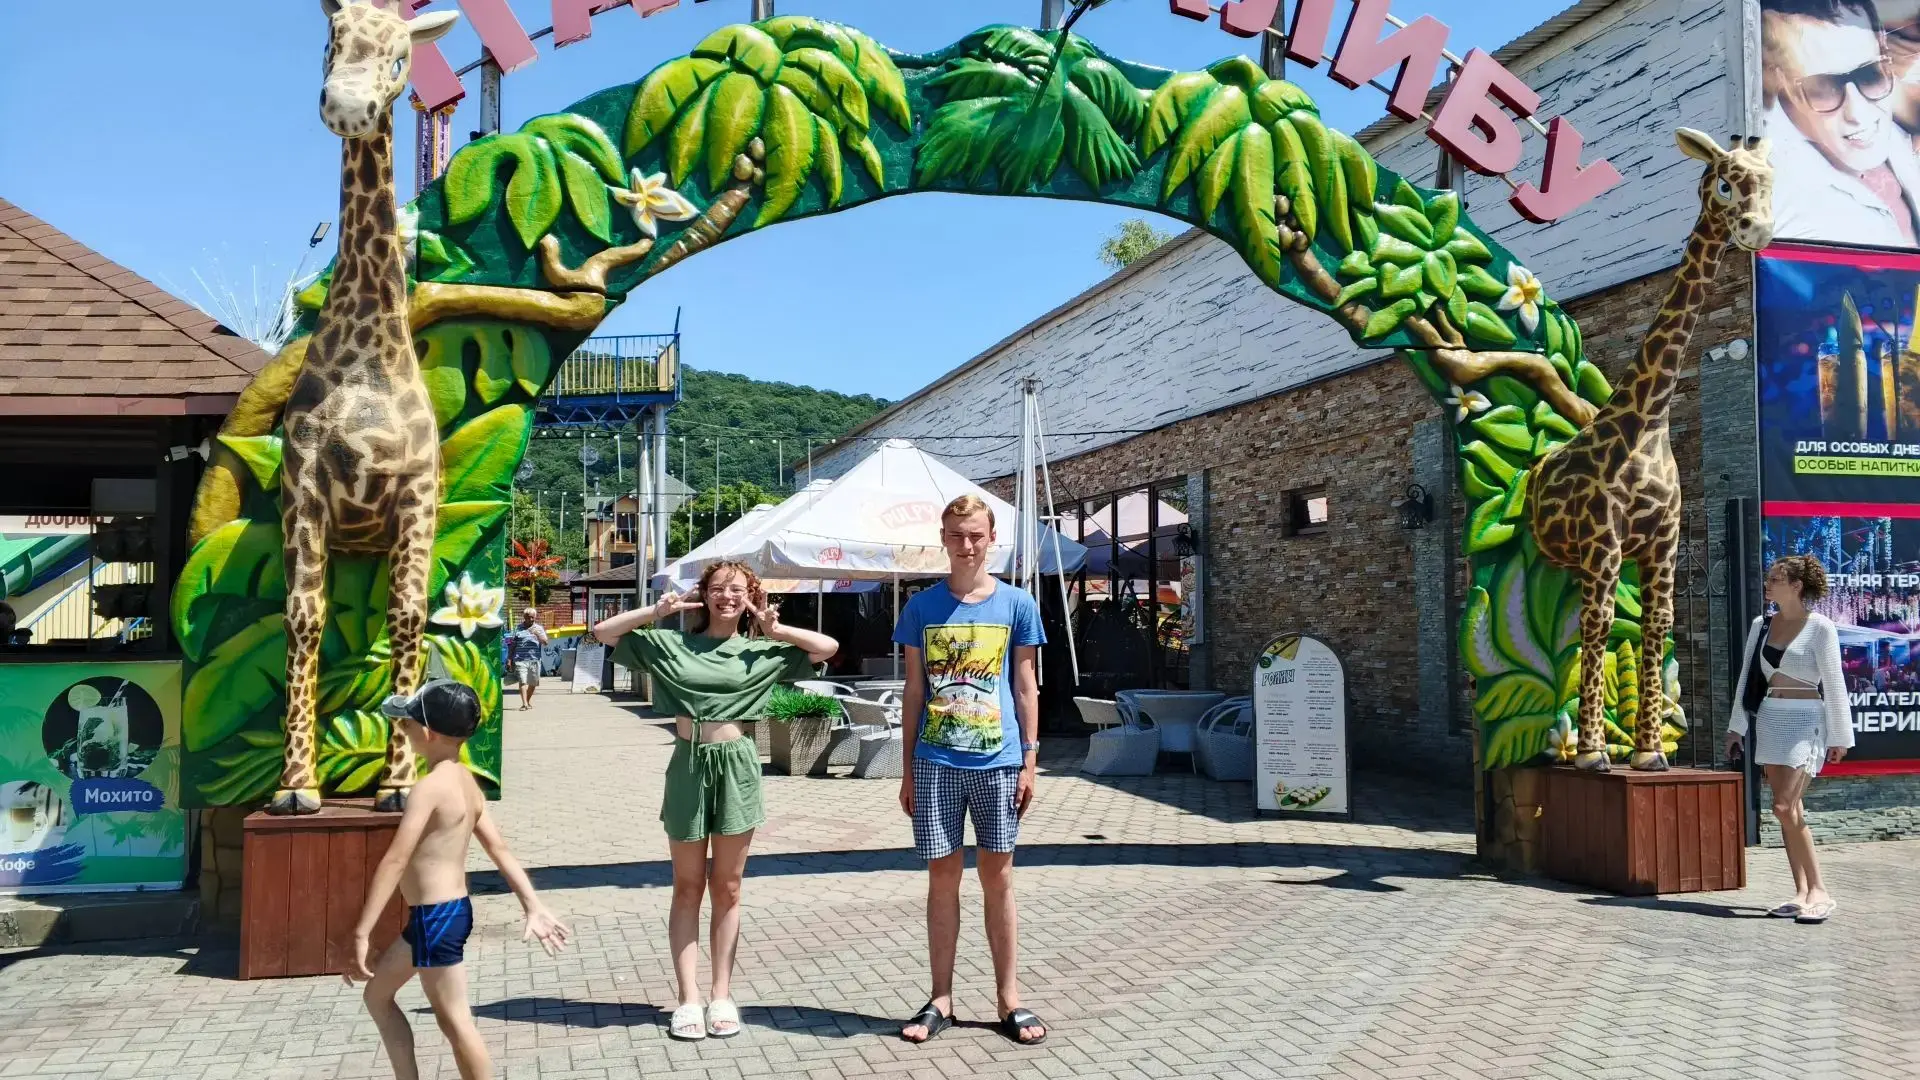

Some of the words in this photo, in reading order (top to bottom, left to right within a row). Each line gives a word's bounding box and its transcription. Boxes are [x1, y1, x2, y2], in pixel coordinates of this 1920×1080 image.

[1796, 440, 1827, 453] ДЛЯ
[1830, 442, 1889, 454] ОСОБЫХ
[1797, 459, 1857, 471] ОСОБЫЕ
[1825, 573, 1883, 588] ЕТНЯЯ
[1887, 573, 1920, 588] ТЕР
[1852, 711, 1920, 733] ЧЕРИ
[84, 788, 153, 804] Мохито
